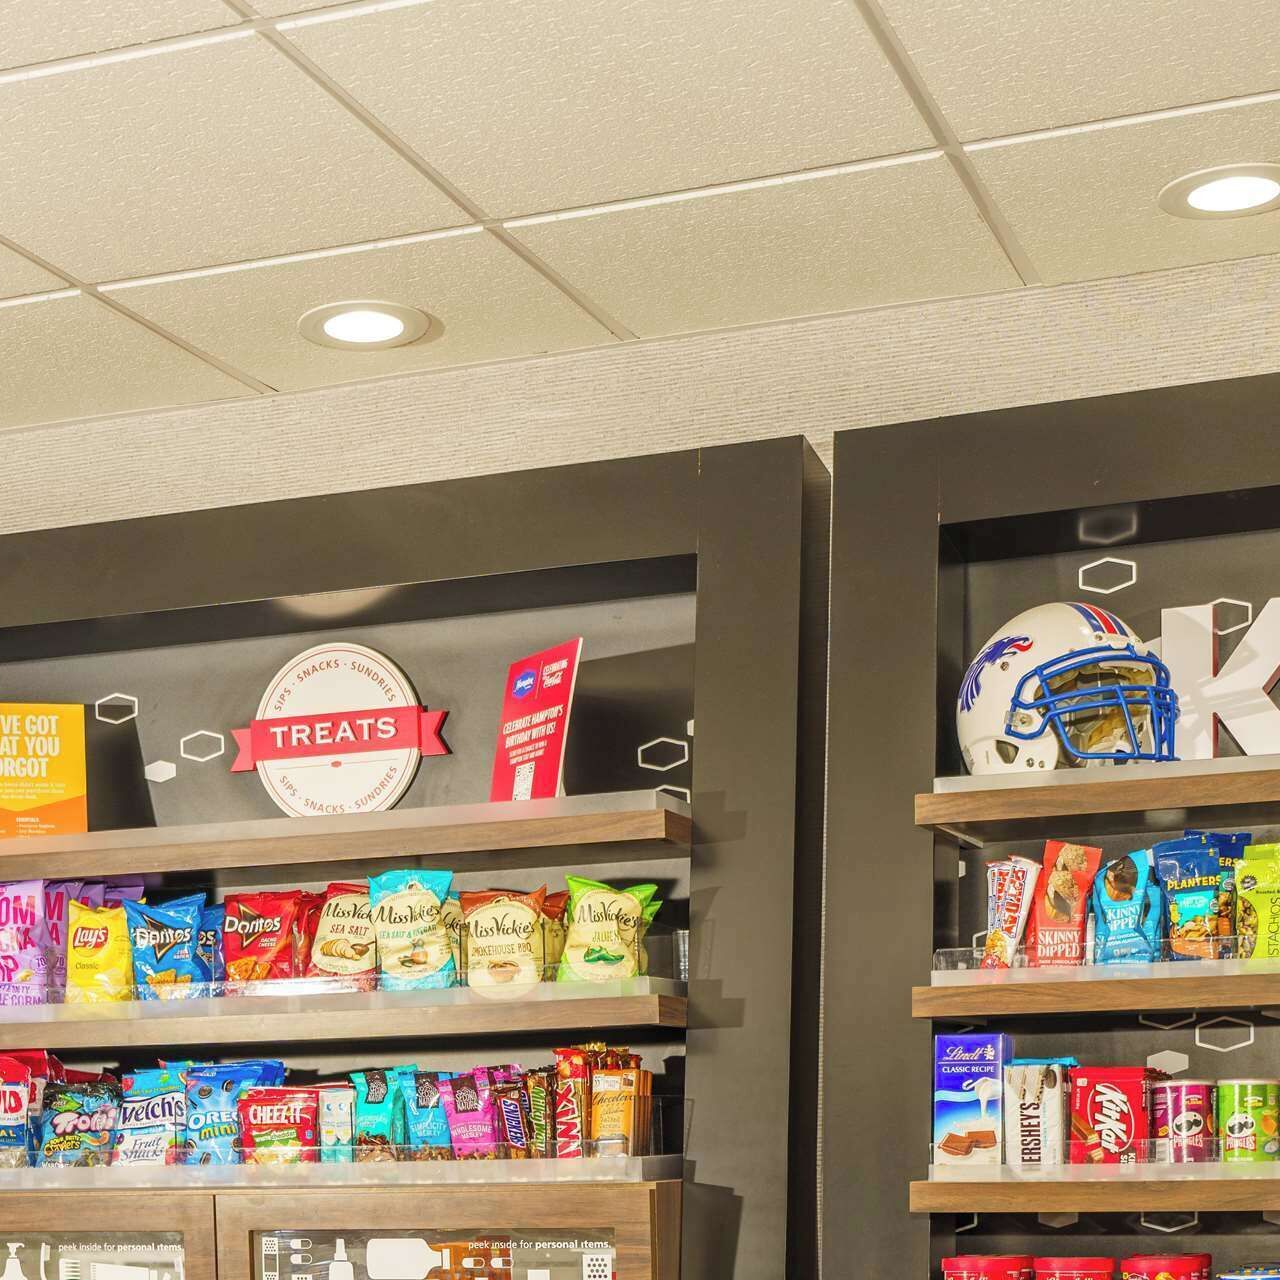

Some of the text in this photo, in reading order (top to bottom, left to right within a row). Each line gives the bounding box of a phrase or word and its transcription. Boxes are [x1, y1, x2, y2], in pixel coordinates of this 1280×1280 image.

[274, 659, 396, 711] SIPS SNACKS SUNDRIES
[25, 715, 59, 735] GOT
[270, 717, 398, 749] TREATS
[503, 713, 532, 735] CELEBRATE
[24, 736, 60, 757] YOU
[505, 730, 531, 748] BIRTHDAY
[279, 766, 398, 813] SIPS SNACKS SUNDRIES
[1167, 876, 1221, 890] PLANTERS
[224, 915, 281, 934] Doritos
[330, 924, 369, 937] SEA SALT
[74, 927, 108, 951] Lay's
[134, 928, 192, 950] Doritos
[1038, 930, 1081, 945] SKINNY
[517, 942, 534, 954] BBQ
[1038, 943, 1080, 957] DIPPED
[75, 962, 99, 970] Classic
[943, 1046, 983, 1060] Lindt
[121, 1097, 185, 1124] Welch's
[199, 1123, 237, 1142] mini
[452, 1124, 493, 1136] WHOLESOME
[502, 1100, 525, 1148] SNICKERS
[1021, 1103, 1041, 1163] ERSHEY'S
[132, 1136, 162, 1149] Fruit
[1225, 1134, 1255, 1150] PRINGLES
[120, 1148, 164, 1161] Snacks
[58, 1243, 77, 1253] peek
[78, 1241, 102, 1252] inside
[103, 1242, 116, 1252] for
[117, 1241, 155, 1253] personal
[468, 1239, 612, 1252] peek inside for personal items.
